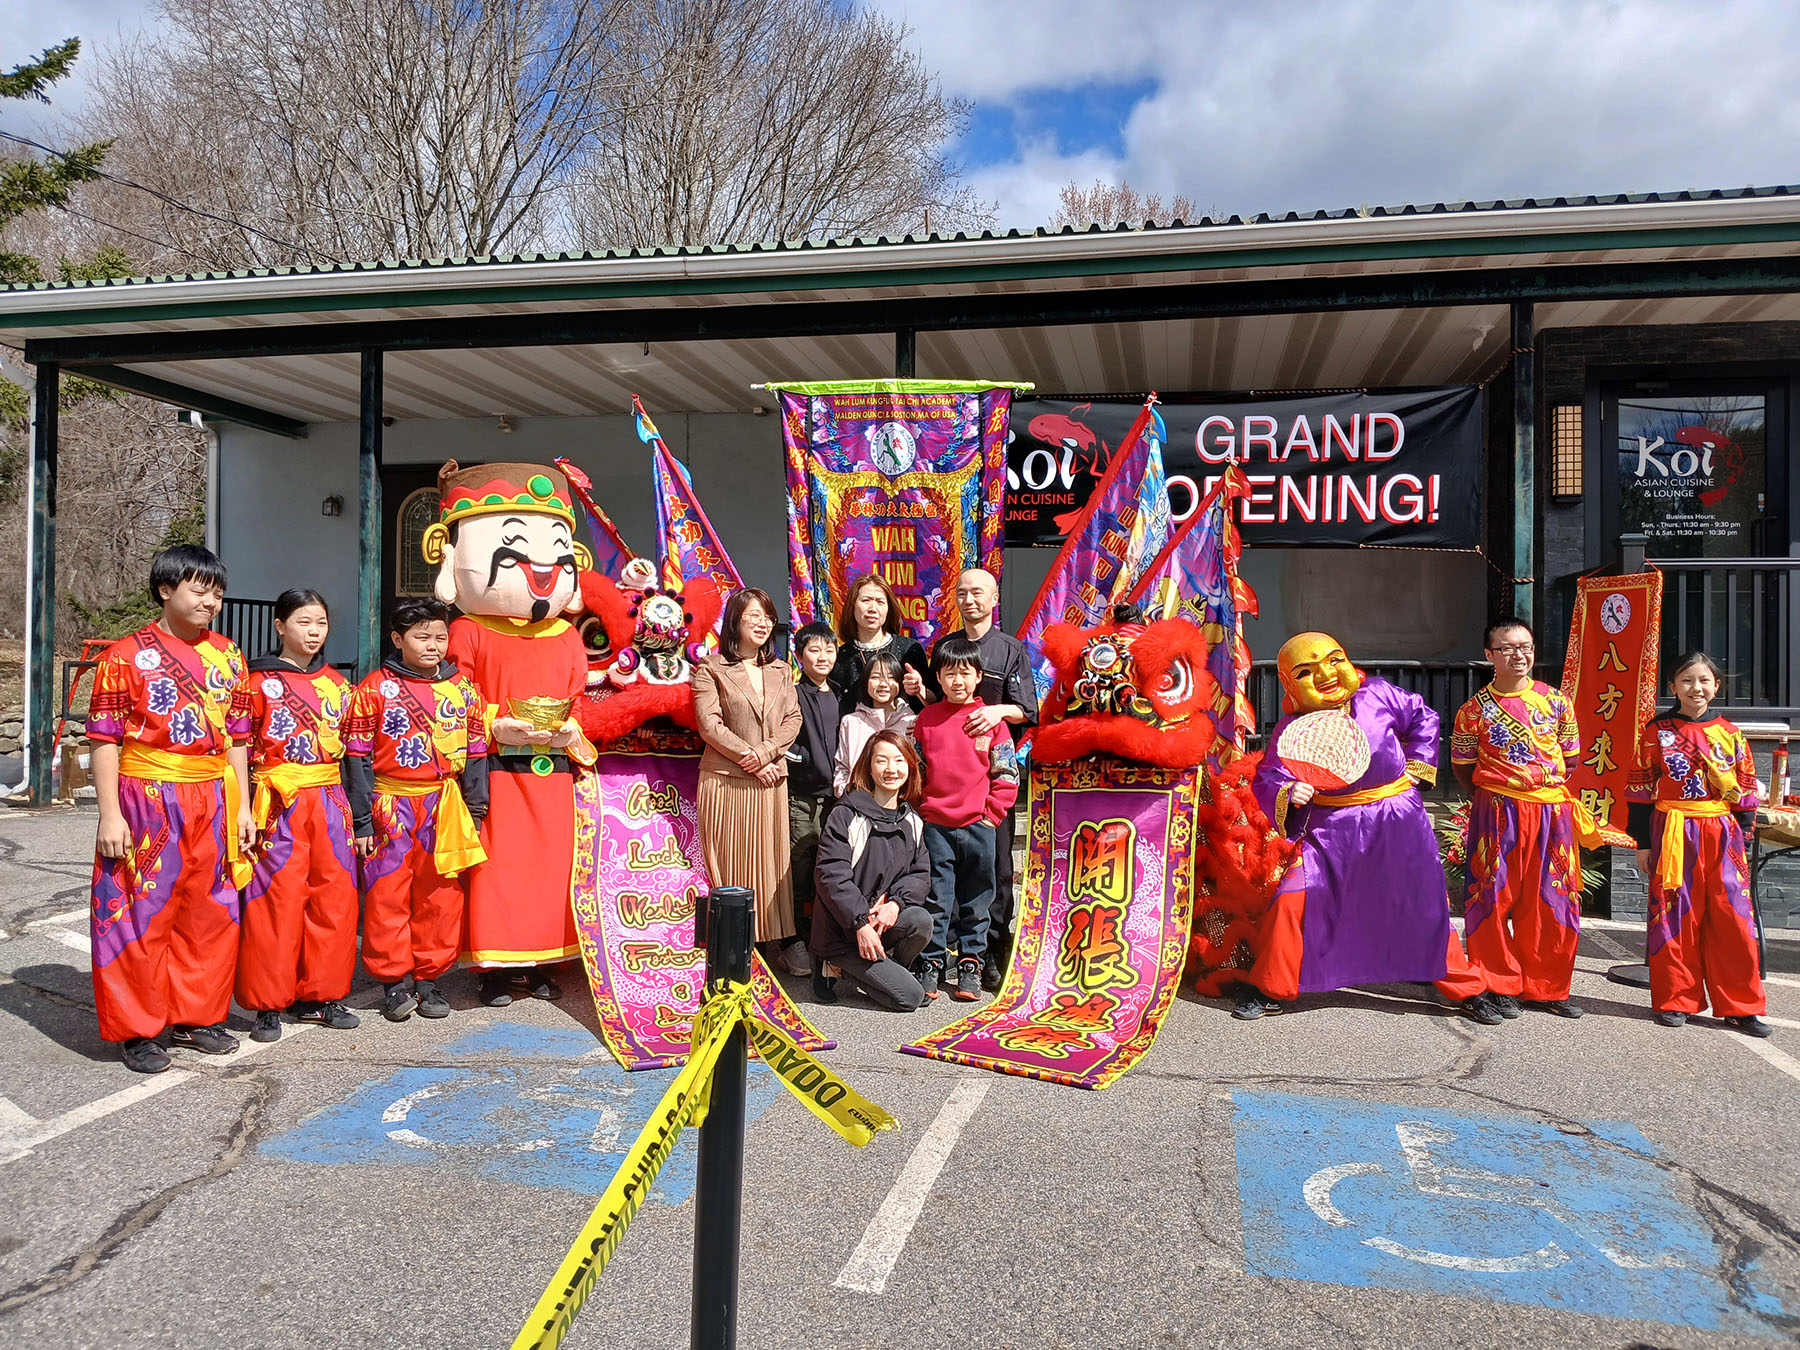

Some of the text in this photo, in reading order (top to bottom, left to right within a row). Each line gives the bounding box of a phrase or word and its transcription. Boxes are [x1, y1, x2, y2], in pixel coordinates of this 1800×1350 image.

[834, 398, 850, 406] WAH
[851, 398, 865, 406] LUM
[907, 397, 919, 405] CHI
[921, 397, 957, 406] ACADEMY
[931, 411, 940, 419] OF
[942, 411, 957, 419] USA
[1197, 413, 1405, 461] GRAND
[1634, 436, 1716, 477] Koi
[1634, 478, 1715, 487] ASIAN CUISINE
[1644, 489, 1695, 498] & LOUNGE
[1021, 494, 1075, 505] CUISINE
[871, 526, 916, 552] WAH
[1092, 557, 1113, 580] FU
[1079, 581, 1100, 607] TAI
[1064, 604, 1086, 628] CHI
[1580, 641, 1629, 828] 八方來財
[628, 782, 679, 818] Good
[627, 838, 691, 871] Luck
[620, 942, 707, 973] Fortun
